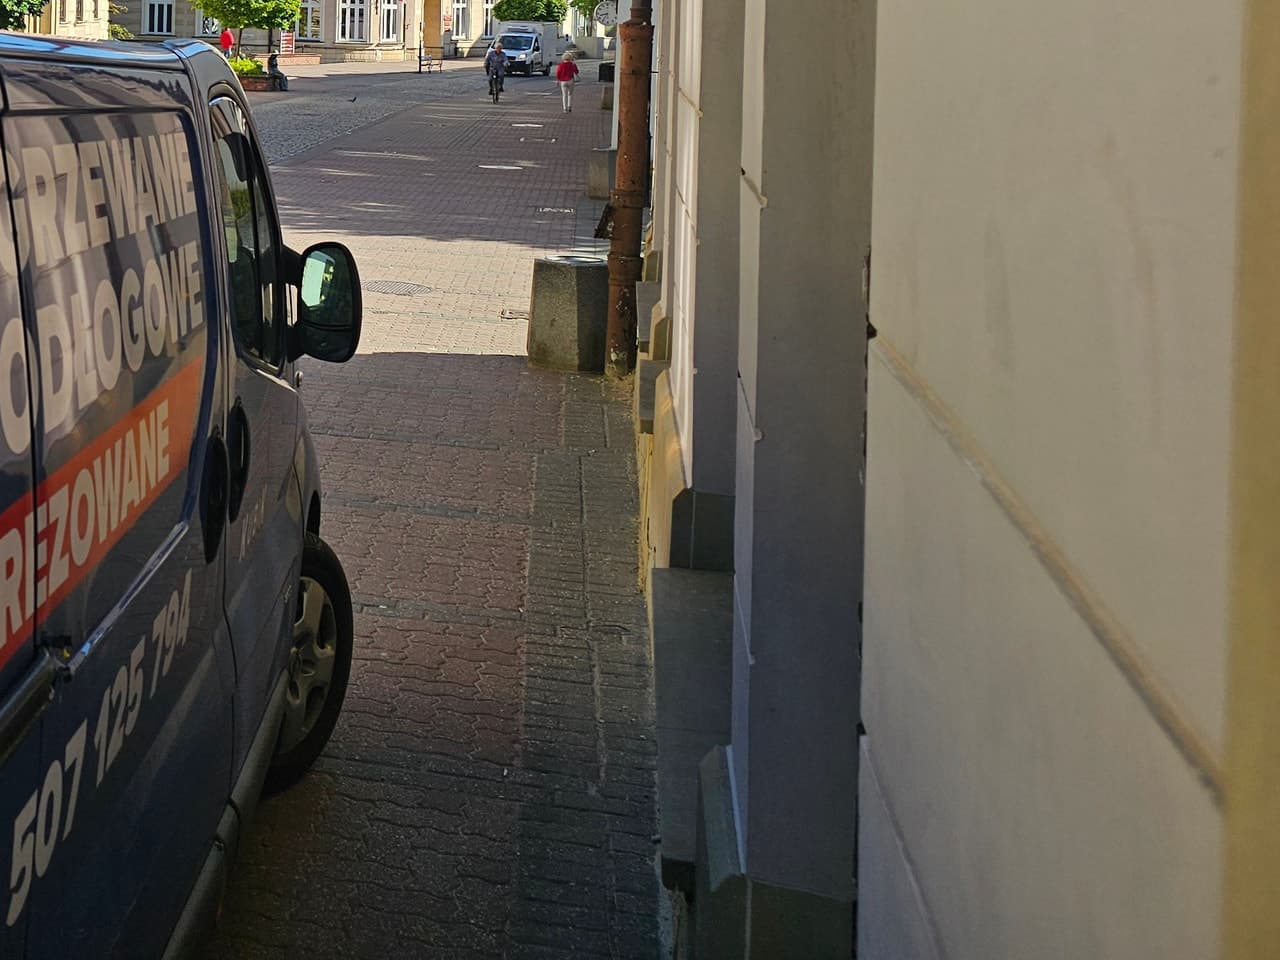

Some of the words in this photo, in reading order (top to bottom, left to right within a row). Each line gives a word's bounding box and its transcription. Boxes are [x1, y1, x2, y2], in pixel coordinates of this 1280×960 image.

[5, 718, 88, 927] 507
[94, 634, 146, 788] 125
[150, 567, 193, 699] 794
